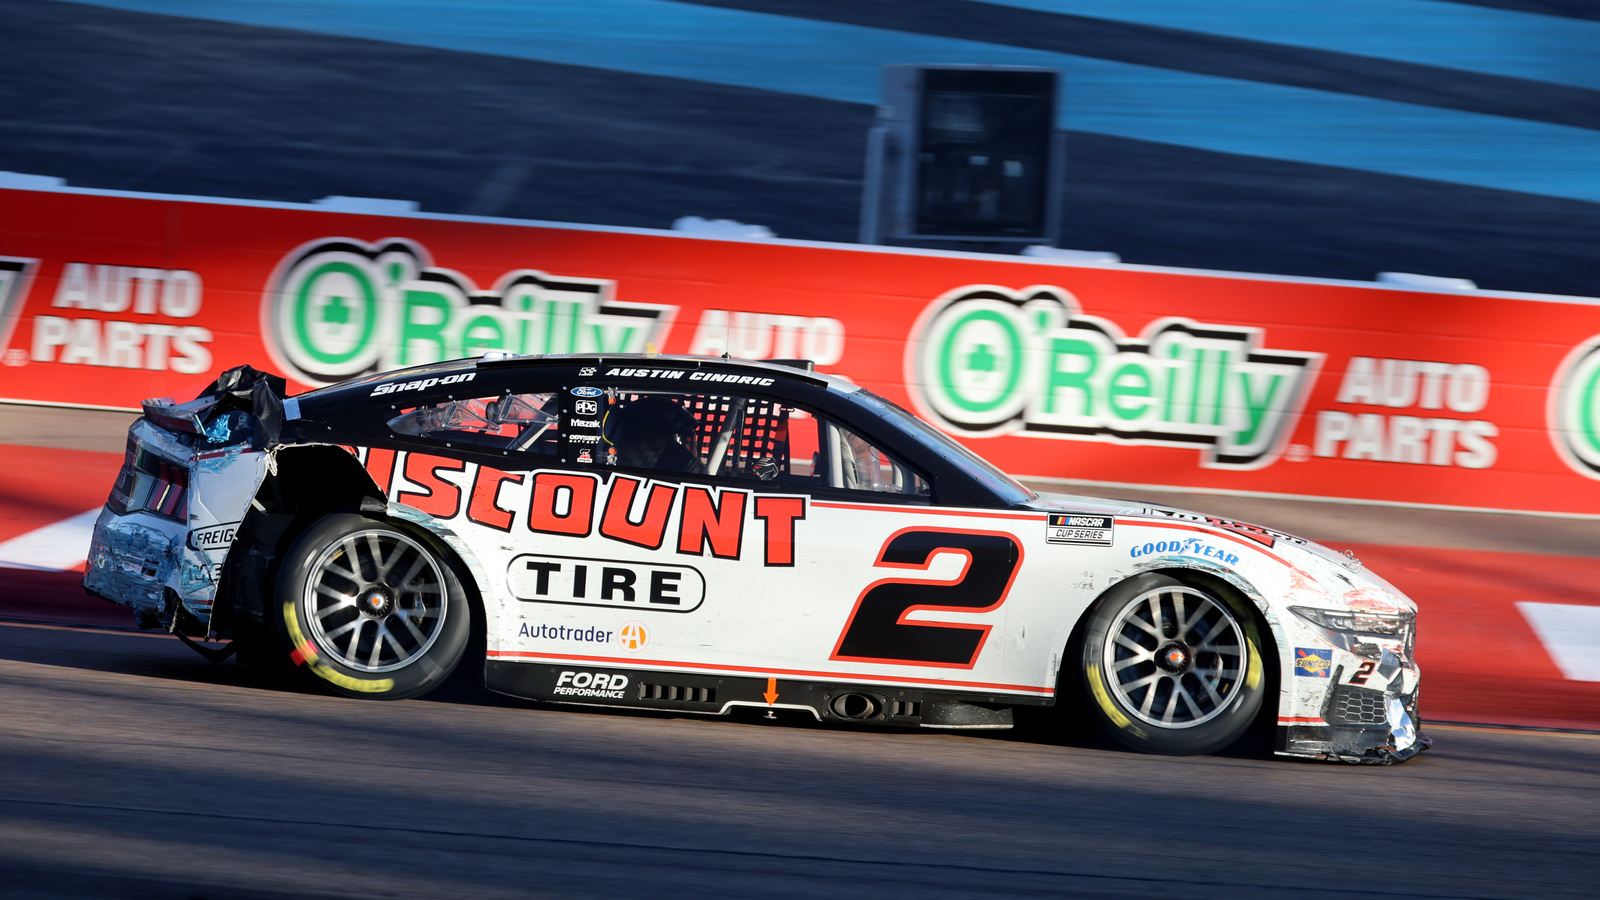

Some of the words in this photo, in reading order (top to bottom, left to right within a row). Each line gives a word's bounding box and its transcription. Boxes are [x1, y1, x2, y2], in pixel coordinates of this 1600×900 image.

[51, 262, 204, 318] AUTO
[30, 315, 214, 374] PARTS
[688, 309, 846, 366] AUTO
[369, 372, 477, 397] Snap-on
[605, 367, 685, 380] AUSTIN
[689, 372, 775, 387] CINDRIC
[934, 304, 1290, 450] O'Reilly
[1335, 356, 1491, 413] AUTO
[577, 401, 597, 413] PPG
[570, 419, 601, 428] Mazak
[1312, 410, 1499, 469] PARTS
[338, 444, 807, 567] ISCOUNT
[1056, 529, 1074, 538] CUP
[1074, 530, 1104, 539] SERIES
[1067, 516, 1105, 527] NASCAR
[526, 561, 683, 605] TIRE
[828, 525, 1025, 670] 2
[518, 622, 613, 643] Autotrader
[556, 671, 629, 690] FORD
[1348, 661, 1376, 685] 2
[553, 687, 625, 699] PERFORMANCE
